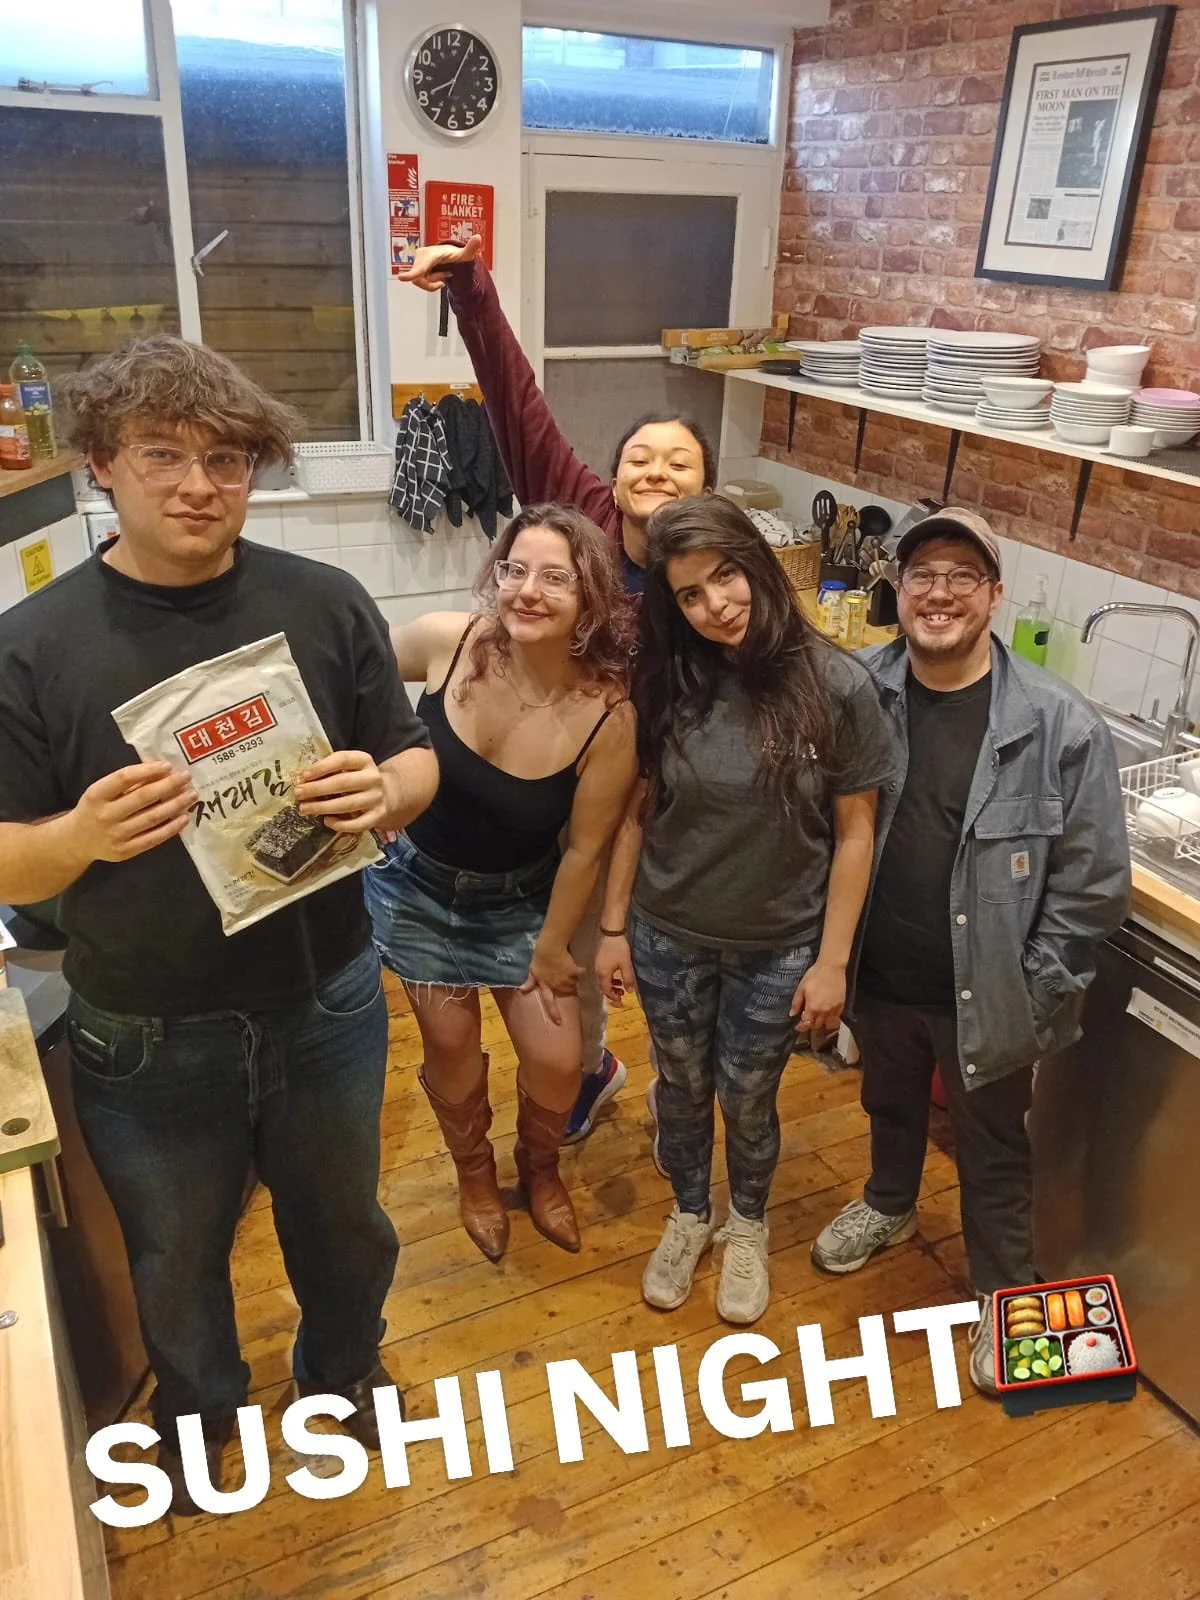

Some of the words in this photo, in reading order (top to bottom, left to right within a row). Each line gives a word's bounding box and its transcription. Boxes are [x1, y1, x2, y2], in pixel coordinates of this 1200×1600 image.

[432, 35, 442, 50] 11
[447, 31, 461, 47] 12
[418, 49, 432, 66] 10
[479, 55, 489, 71] 2
[413, 69, 424, 85] 9
[484, 77, 493, 92] 3
[418, 90, 429, 106] 8
[1035, 88, 1061, 101] FIRST
[1062, 86, 1083, 99] MAN
[1084, 86, 1100, 97] ON
[1102, 84, 1120, 96] THE
[476, 96, 488, 112] 4
[1037, 101, 1066, 112] MOON
[431, 107, 441, 121] 7
[447, 114, 459, 129] 6
[465, 111, 475, 125] 5
[450, 193, 475, 206] FIRE
[441, 204, 484, 218] BLANKET
[187, 705, 264, 750] 대천김
[211, 736, 264, 765] 1588-9293
[187, 759, 292, 828] 재래김
